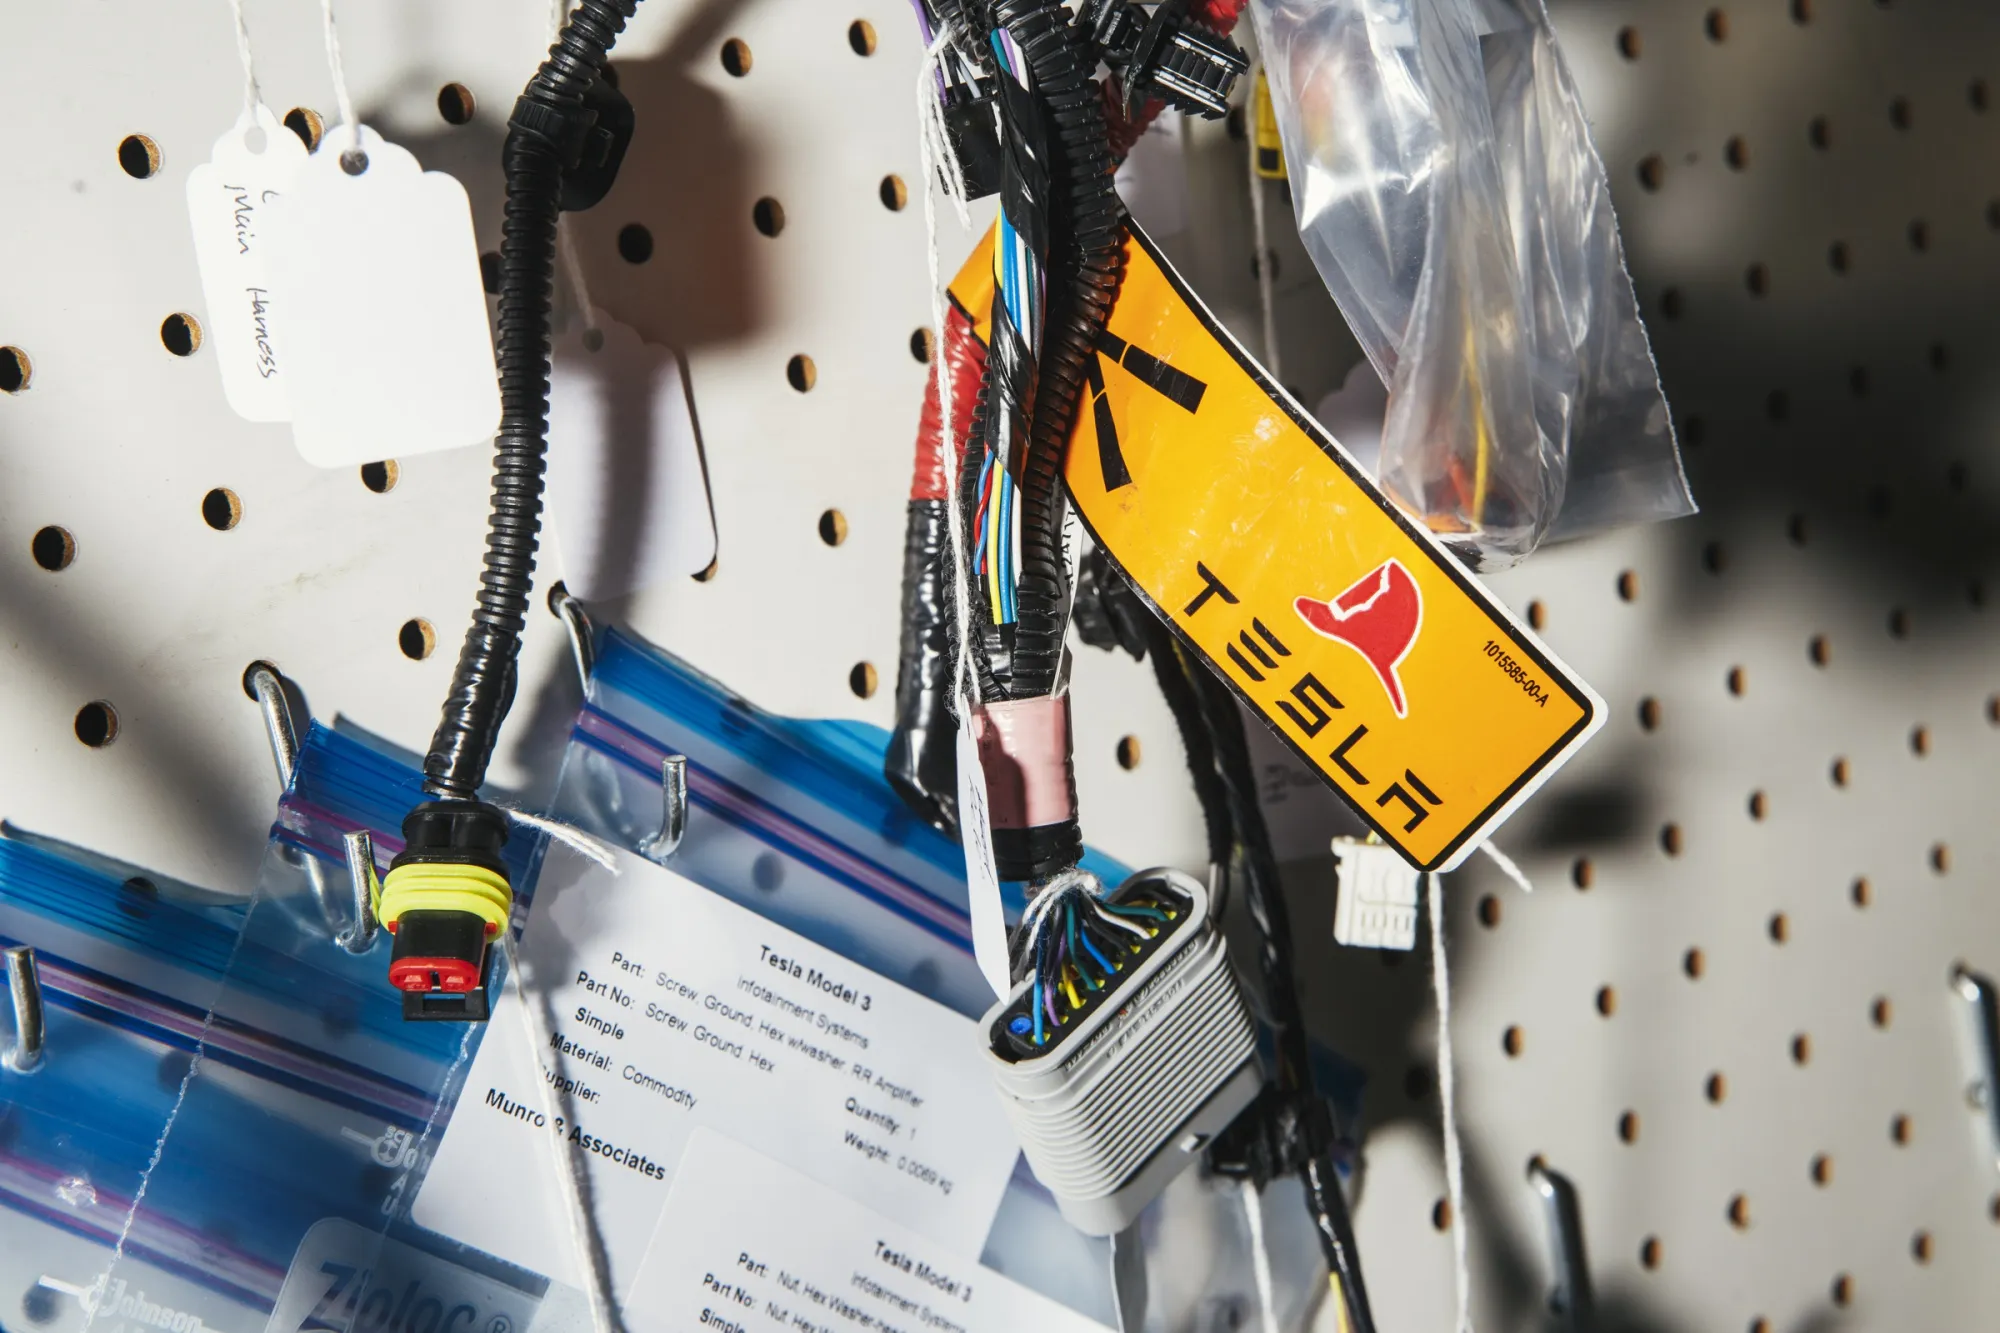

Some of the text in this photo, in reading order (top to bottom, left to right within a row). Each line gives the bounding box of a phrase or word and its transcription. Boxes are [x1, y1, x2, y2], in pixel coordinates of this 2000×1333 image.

[224, 184, 278, 379] Main Harness
[1184, 561, 1443, 833] TESLA
[1483, 640, 1549, 708] 1015585-00-A
[737, 976, 869, 1050] Infotainment Systems
[761, 944, 872, 1012] Tesla Model 3
[575, 1006, 625, 1041] Simple
[576, 970, 607, 997] Part
[609, 986, 636, 1010] No:
[748, 1049, 776, 1073] Hex
[611, 951, 646, 979] Part:
[758, 1020, 785, 1043] Hex
[851, 1063, 873, 1083] RR
[541, 1064, 601, 1105] upplier:
[550, 1031, 698, 1112] Material: Commodity
[484, 1088, 666, 1181] Munro & Associates
[702, 1272, 732, 1300] Part
[731, 1285, 758, 1311] No:
[736, 1251, 770, 1280] Part:
[801, 1282, 830, 1307] Hex
[874, 1239, 973, 1304] Tesla Model 3
